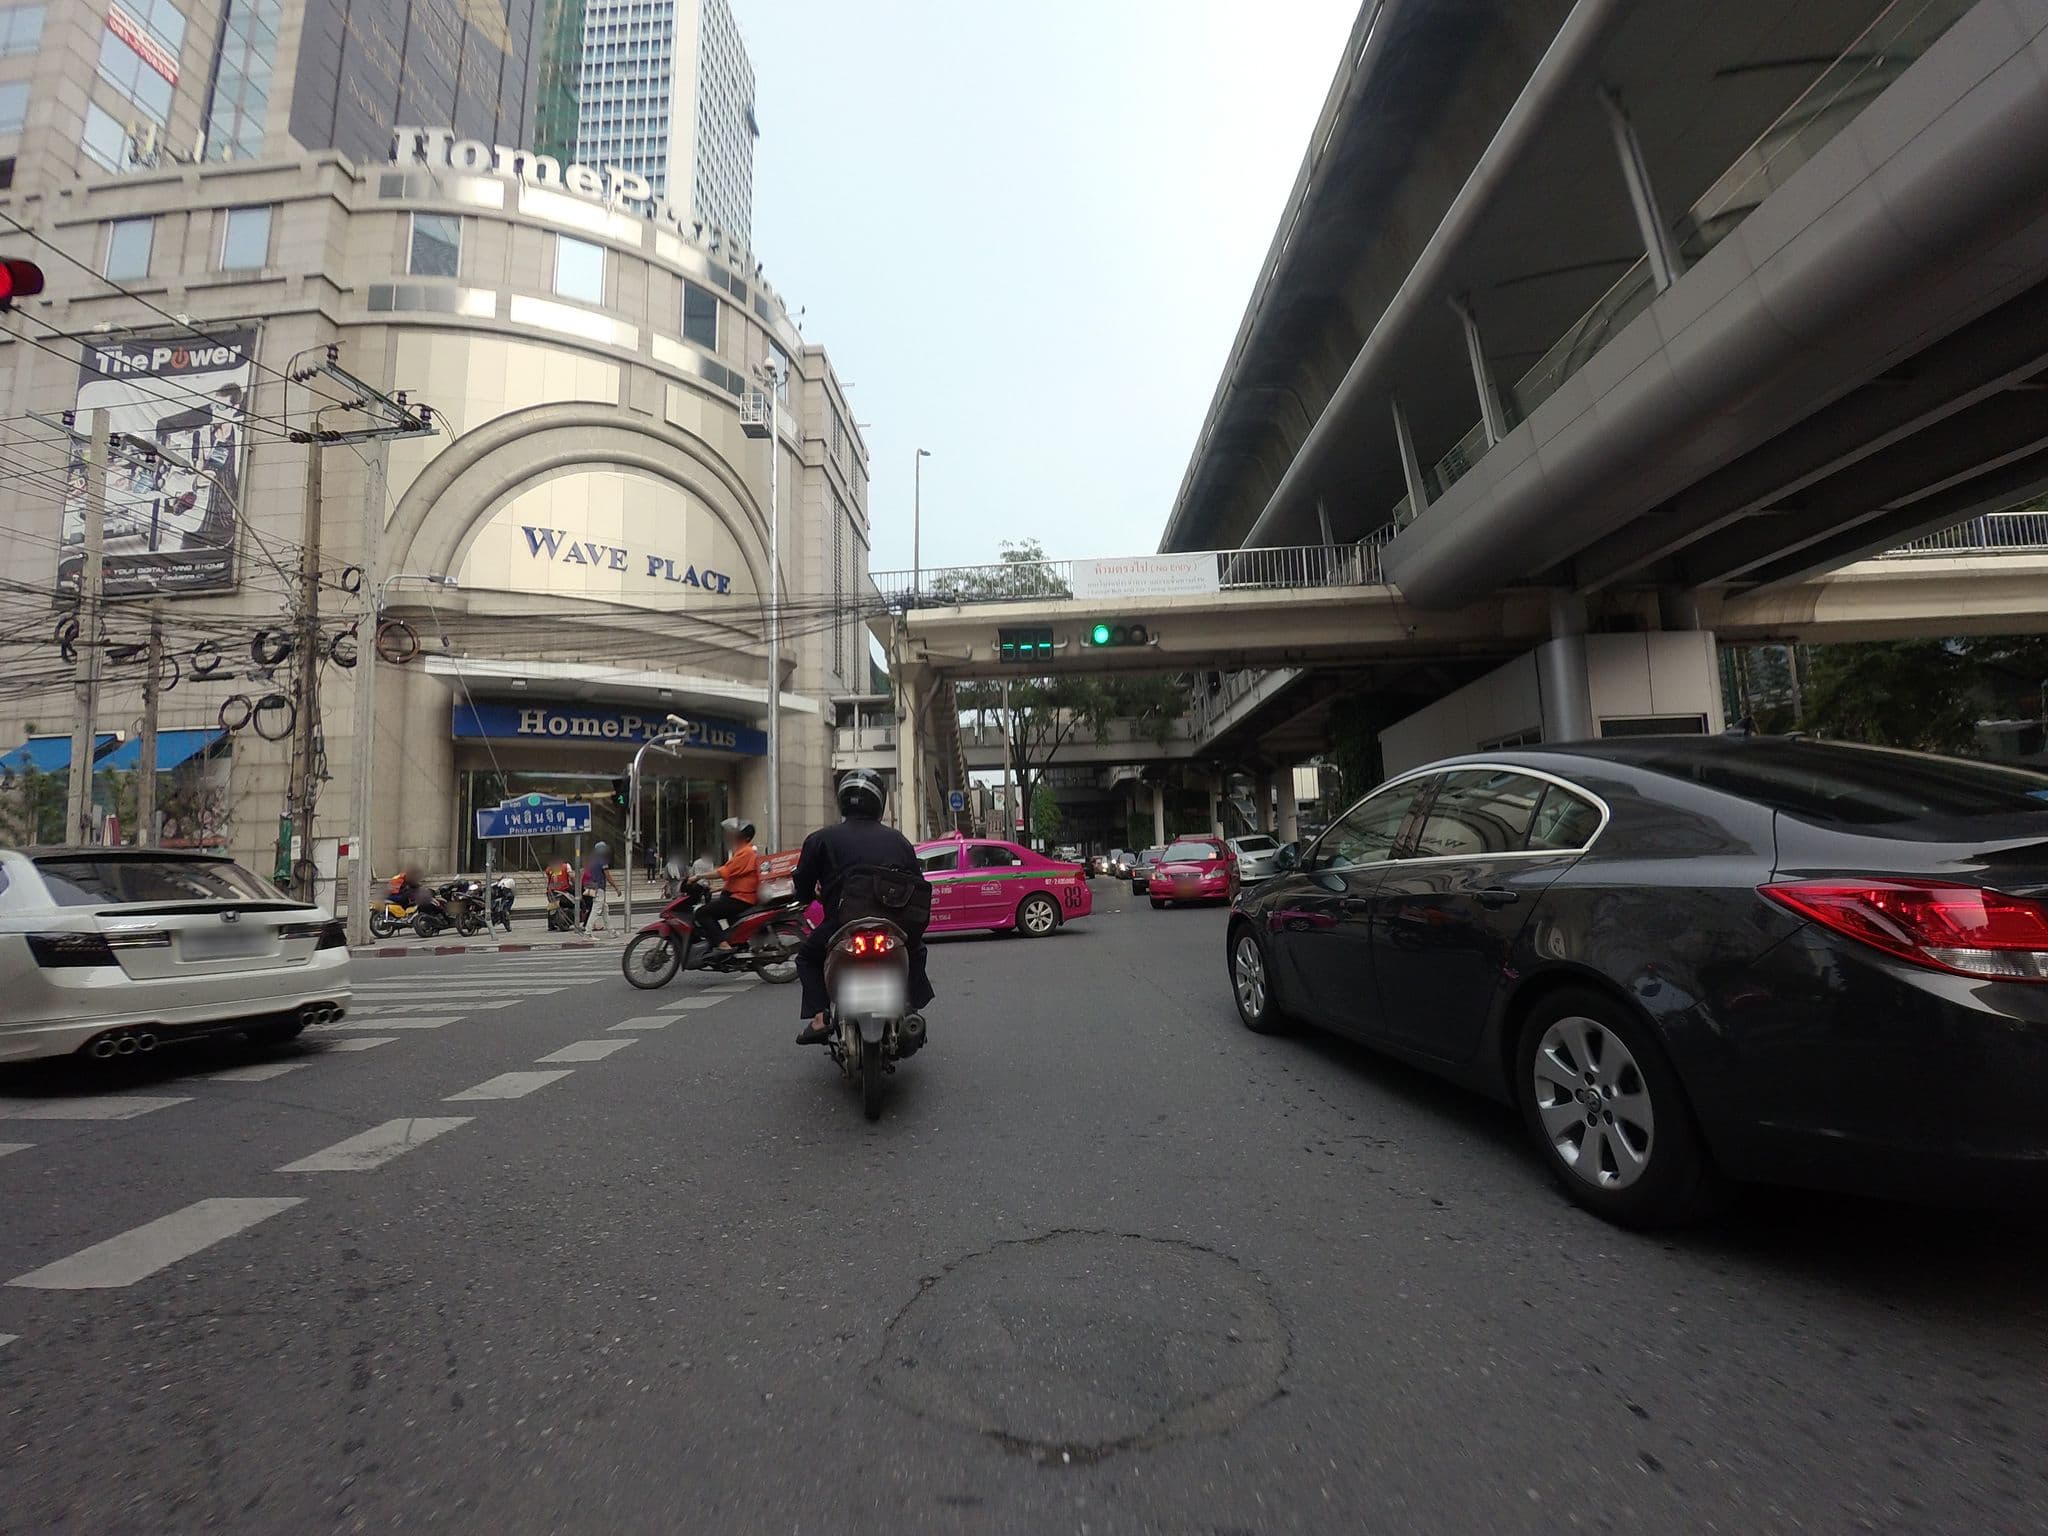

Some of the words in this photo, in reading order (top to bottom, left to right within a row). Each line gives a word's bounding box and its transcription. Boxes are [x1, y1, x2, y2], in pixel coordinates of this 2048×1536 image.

[95, 349, 149, 374] The
[151, 344, 242, 372] Power
[521, 525, 630, 572] WAVE
[646, 554, 732, 596] PLACE
[505, 808, 565, 826] เพลินจิต
[1063, 885, 1083, 909] 83
